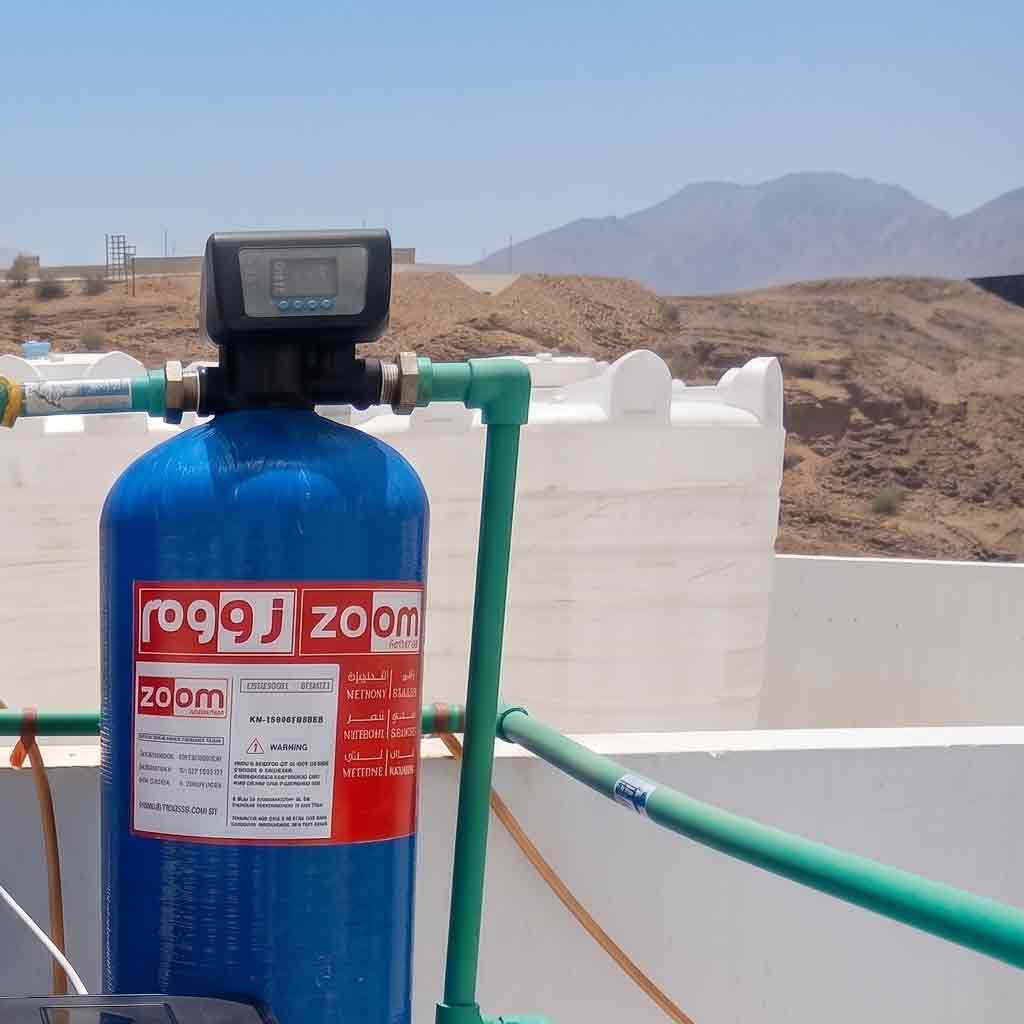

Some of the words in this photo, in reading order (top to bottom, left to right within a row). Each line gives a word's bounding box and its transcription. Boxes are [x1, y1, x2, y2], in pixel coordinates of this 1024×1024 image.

[310, 604, 420, 640] zoom
[140, 686, 225, 710] zoom
[270, 743, 309, 752] WARNING
